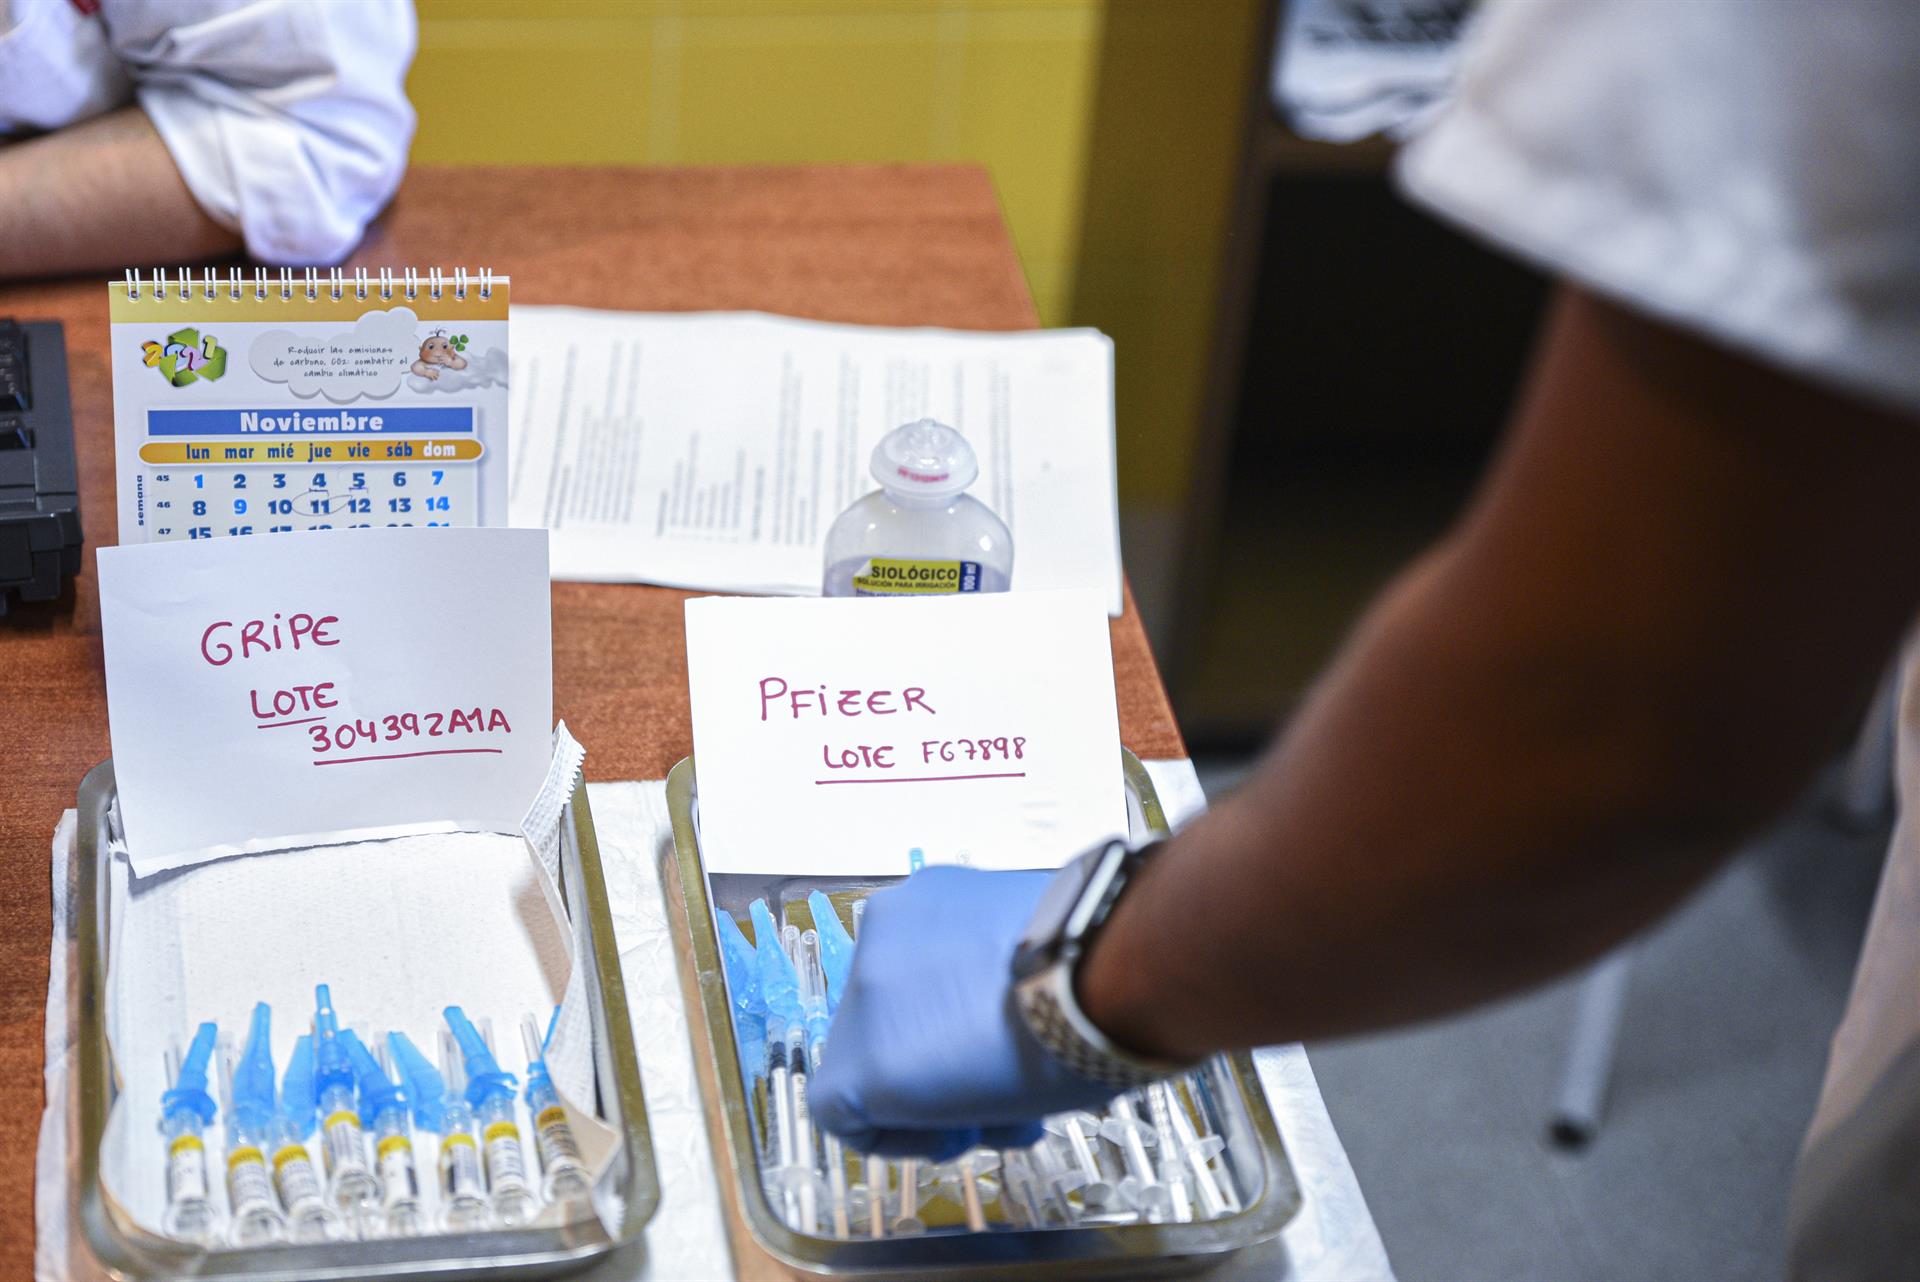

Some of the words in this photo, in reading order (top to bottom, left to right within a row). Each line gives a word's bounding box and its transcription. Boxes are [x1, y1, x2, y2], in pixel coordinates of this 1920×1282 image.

[288, 346, 325, 355] Reducir
[330, 346, 343, 354] las
[348, 346, 393, 354] emisiones
[273, 358, 284, 366] de
[354, 357, 394, 366] combatir
[399, 357, 408, 365] el
[304, 368, 333, 377] cambio
[338, 368, 378, 377] climático
[240, 411, 383, 432] Noviembre
[186, 443, 210, 459] lun
[225, 447, 254, 459] mar
[267, 442, 294, 458] mié
[307, 442, 332, 462] jue
[348, 442, 370, 457] vie
[386, 441, 413, 457] sáb
[423, 440, 456, 457] dom
[194, 474, 203, 489] 1
[233, 473, 246, 489] 2
[273, 473, 286, 488] 3
[312, 473, 327, 487] 4
[352, 472, 365, 487] 5
[393, 472, 406, 487] 6
[431, 471, 444, 485] 7
[192, 500, 206, 516] 8
[234, 499, 247, 514] 9
[268, 499, 293, 514] 10
[310, 499, 329, 514] 11
[348, 498, 371, 513] 12
[388, 498, 411, 513] 13
[425, 496, 450, 511] 14
[188, 527, 212, 540] 15
[250, 682, 338, 719] LOTE
[308, 707, 512, 753] 304392A1A
[823, 744, 896, 769] LOTE
